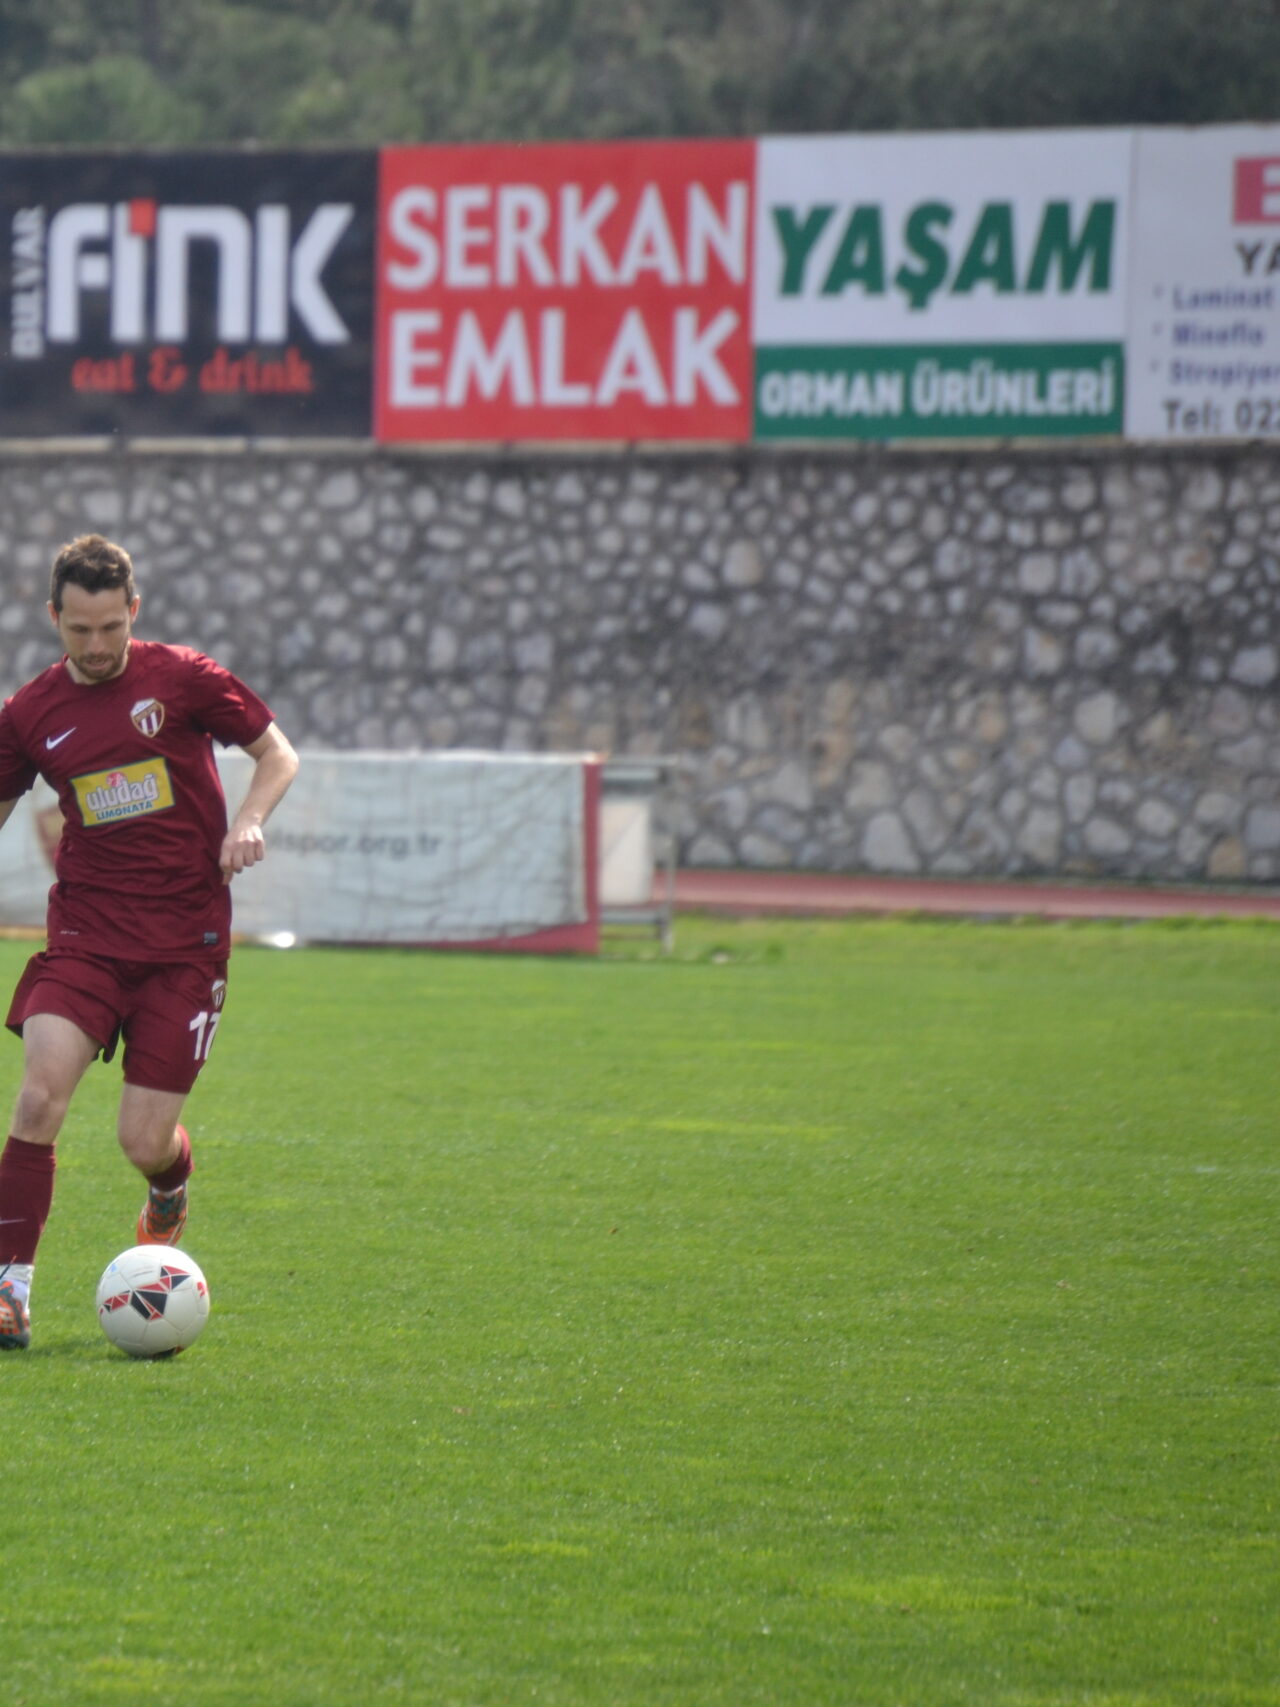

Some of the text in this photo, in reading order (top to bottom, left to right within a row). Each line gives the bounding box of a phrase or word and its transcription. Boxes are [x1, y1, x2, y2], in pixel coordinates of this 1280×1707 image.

[386, 180, 749, 291] SERKAN
[770, 198, 1117, 312] YAŞAM
[71, 346, 314, 394] eat & drink
[388, 306, 741, 409] EMLAK
[759, 370, 904, 418] ORMAN
